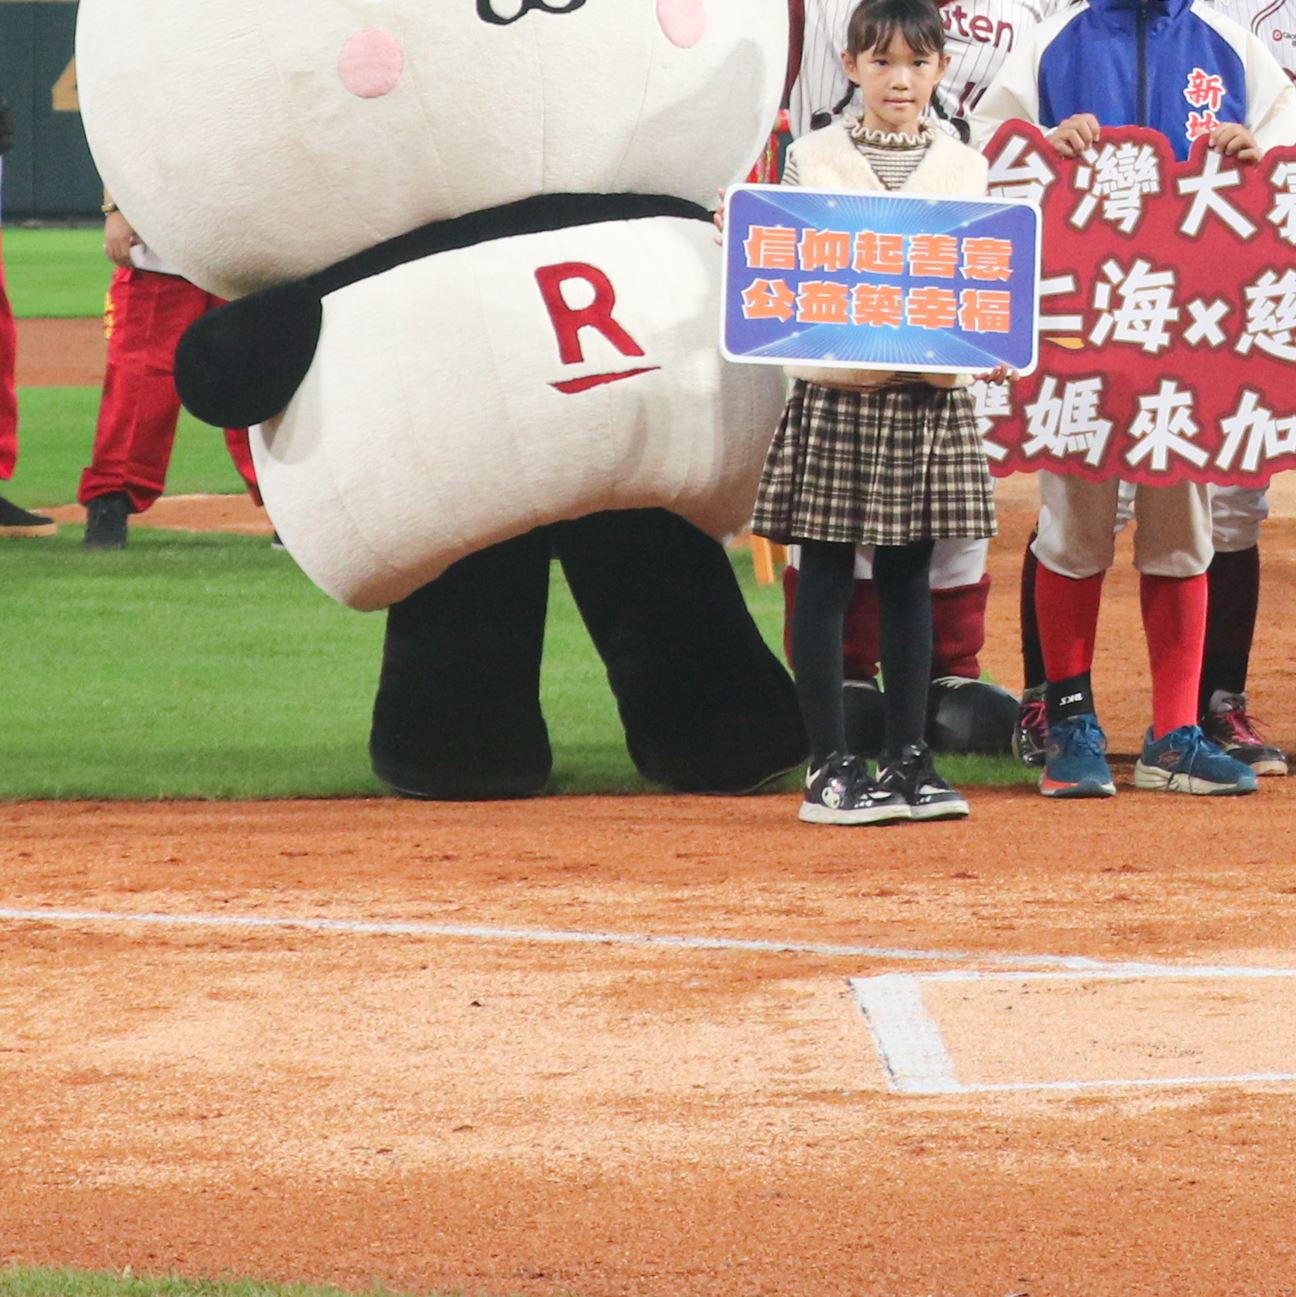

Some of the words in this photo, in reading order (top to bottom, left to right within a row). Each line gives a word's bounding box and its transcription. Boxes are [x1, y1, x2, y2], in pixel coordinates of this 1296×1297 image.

[743, 225, 1013, 281] 信仰起善意
[534, 261, 646, 364] R
[741, 278, 1012, 333] 公益築幸福
